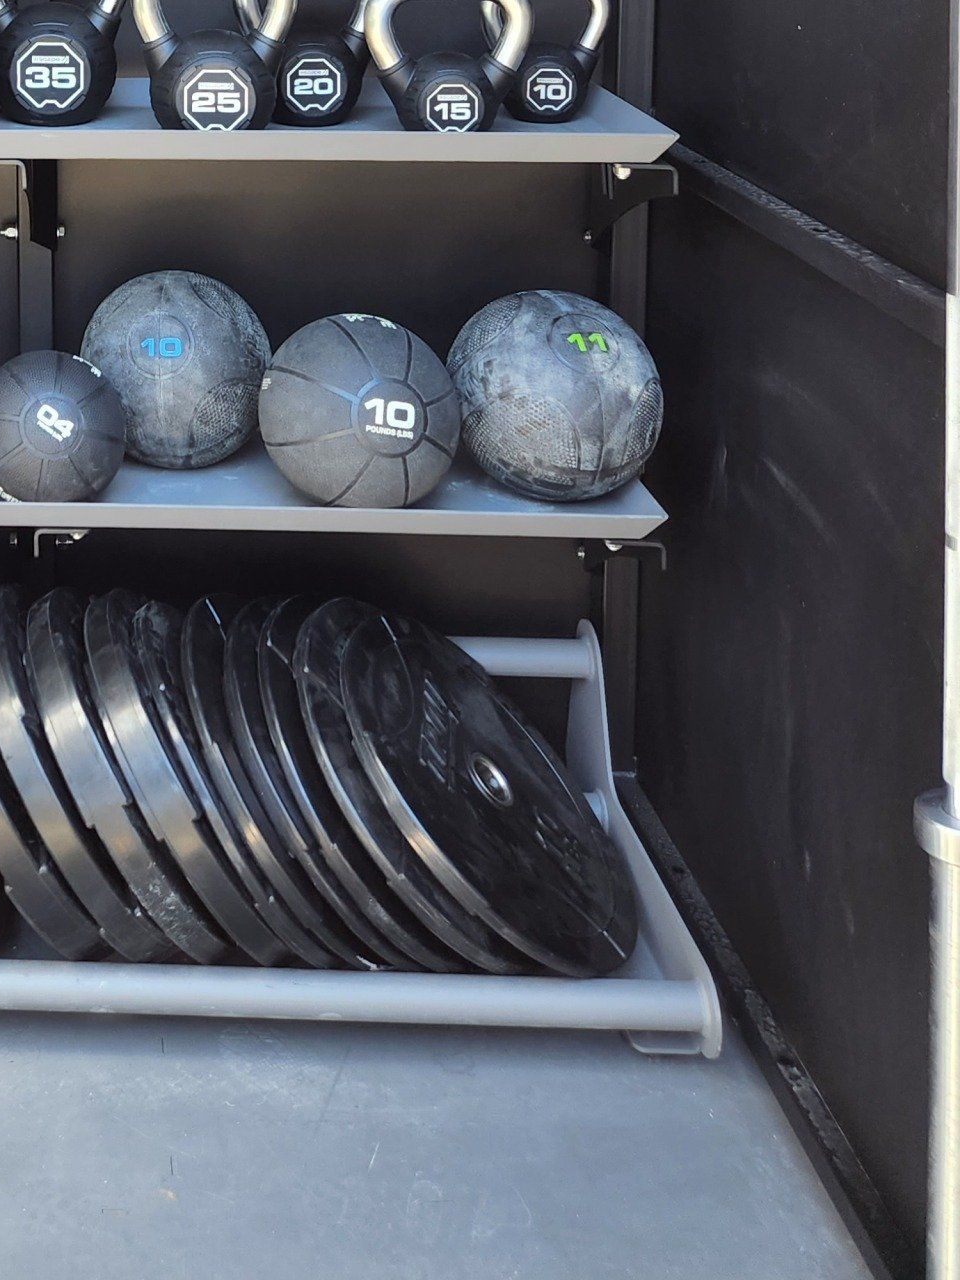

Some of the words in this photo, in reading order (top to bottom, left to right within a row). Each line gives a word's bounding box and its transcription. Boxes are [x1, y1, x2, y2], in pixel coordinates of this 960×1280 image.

[25, 66, 77, 89] 35
[293, 77, 334, 95] 20
[191, 91, 241, 113] 25
[532, 84, 567, 100] 10
[433, 102, 471, 120] 15
[140, 336, 183, 358] 10
[566, 332, 609, 353] 11
[36, 404, 75, 439] 04
[364, 397, 415, 429] 10
[365, 424, 396, 437] POUNDS
